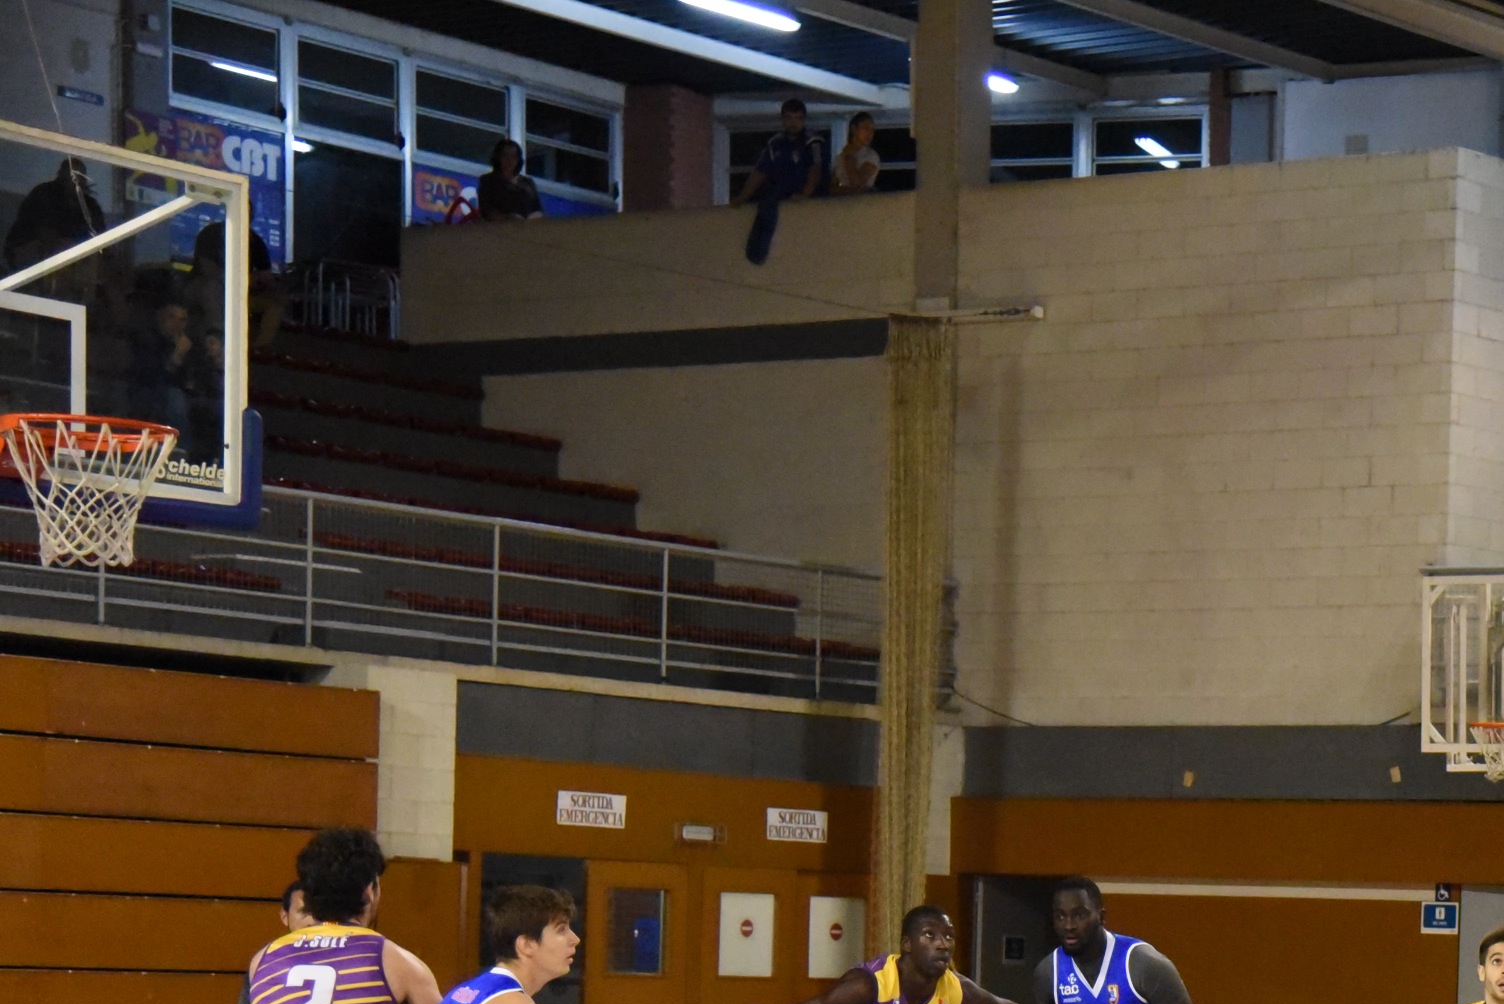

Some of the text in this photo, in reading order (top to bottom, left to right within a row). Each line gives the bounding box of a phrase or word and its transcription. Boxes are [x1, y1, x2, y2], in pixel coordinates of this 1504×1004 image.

[222, 136, 281, 182] CBT
[570, 793, 614, 810] SORTIDA
[559, 808, 624, 827] EMERGENCIA
[778, 810, 817, 826] SORTIDA
[768, 825, 826, 840] EMERGENCIA
